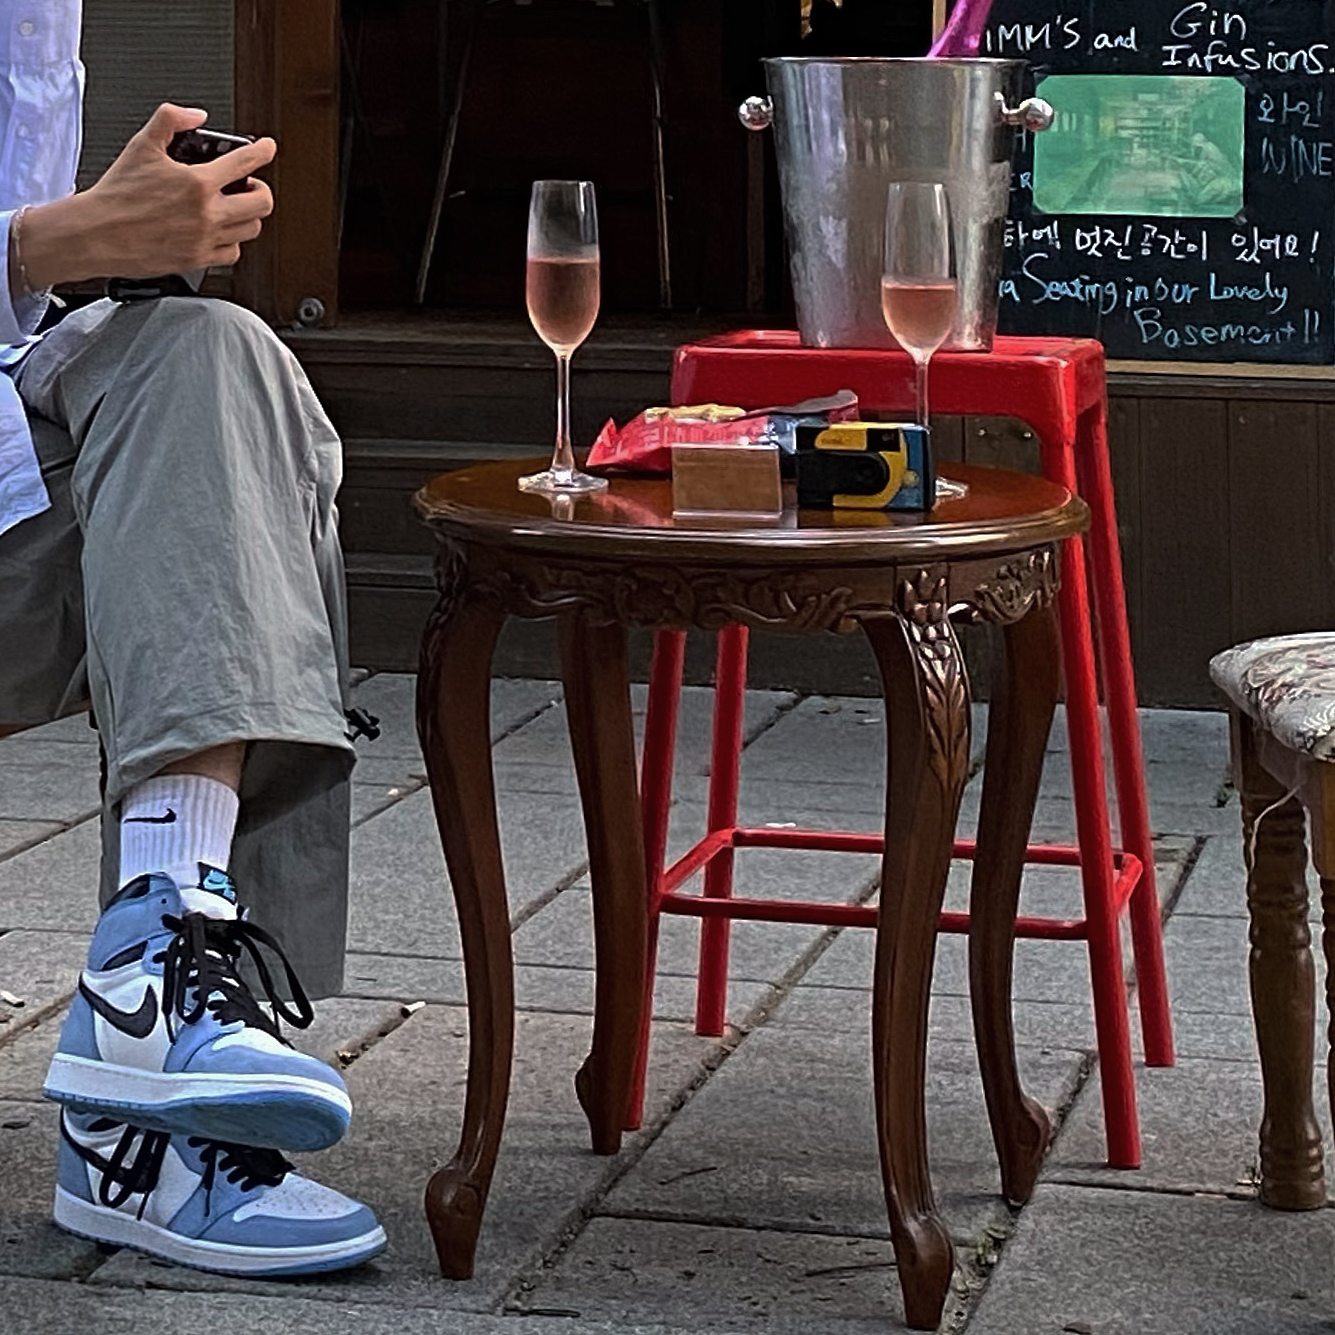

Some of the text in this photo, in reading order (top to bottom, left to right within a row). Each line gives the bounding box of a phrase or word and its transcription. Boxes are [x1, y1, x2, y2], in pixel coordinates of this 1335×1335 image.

[984, 2, 1247, 55] IMM'S and Gin
[1257, 90, 1323, 128] 와인
[1261, 134, 1334, 180] WINE
[1209, 270, 1289, 315] Lovely
